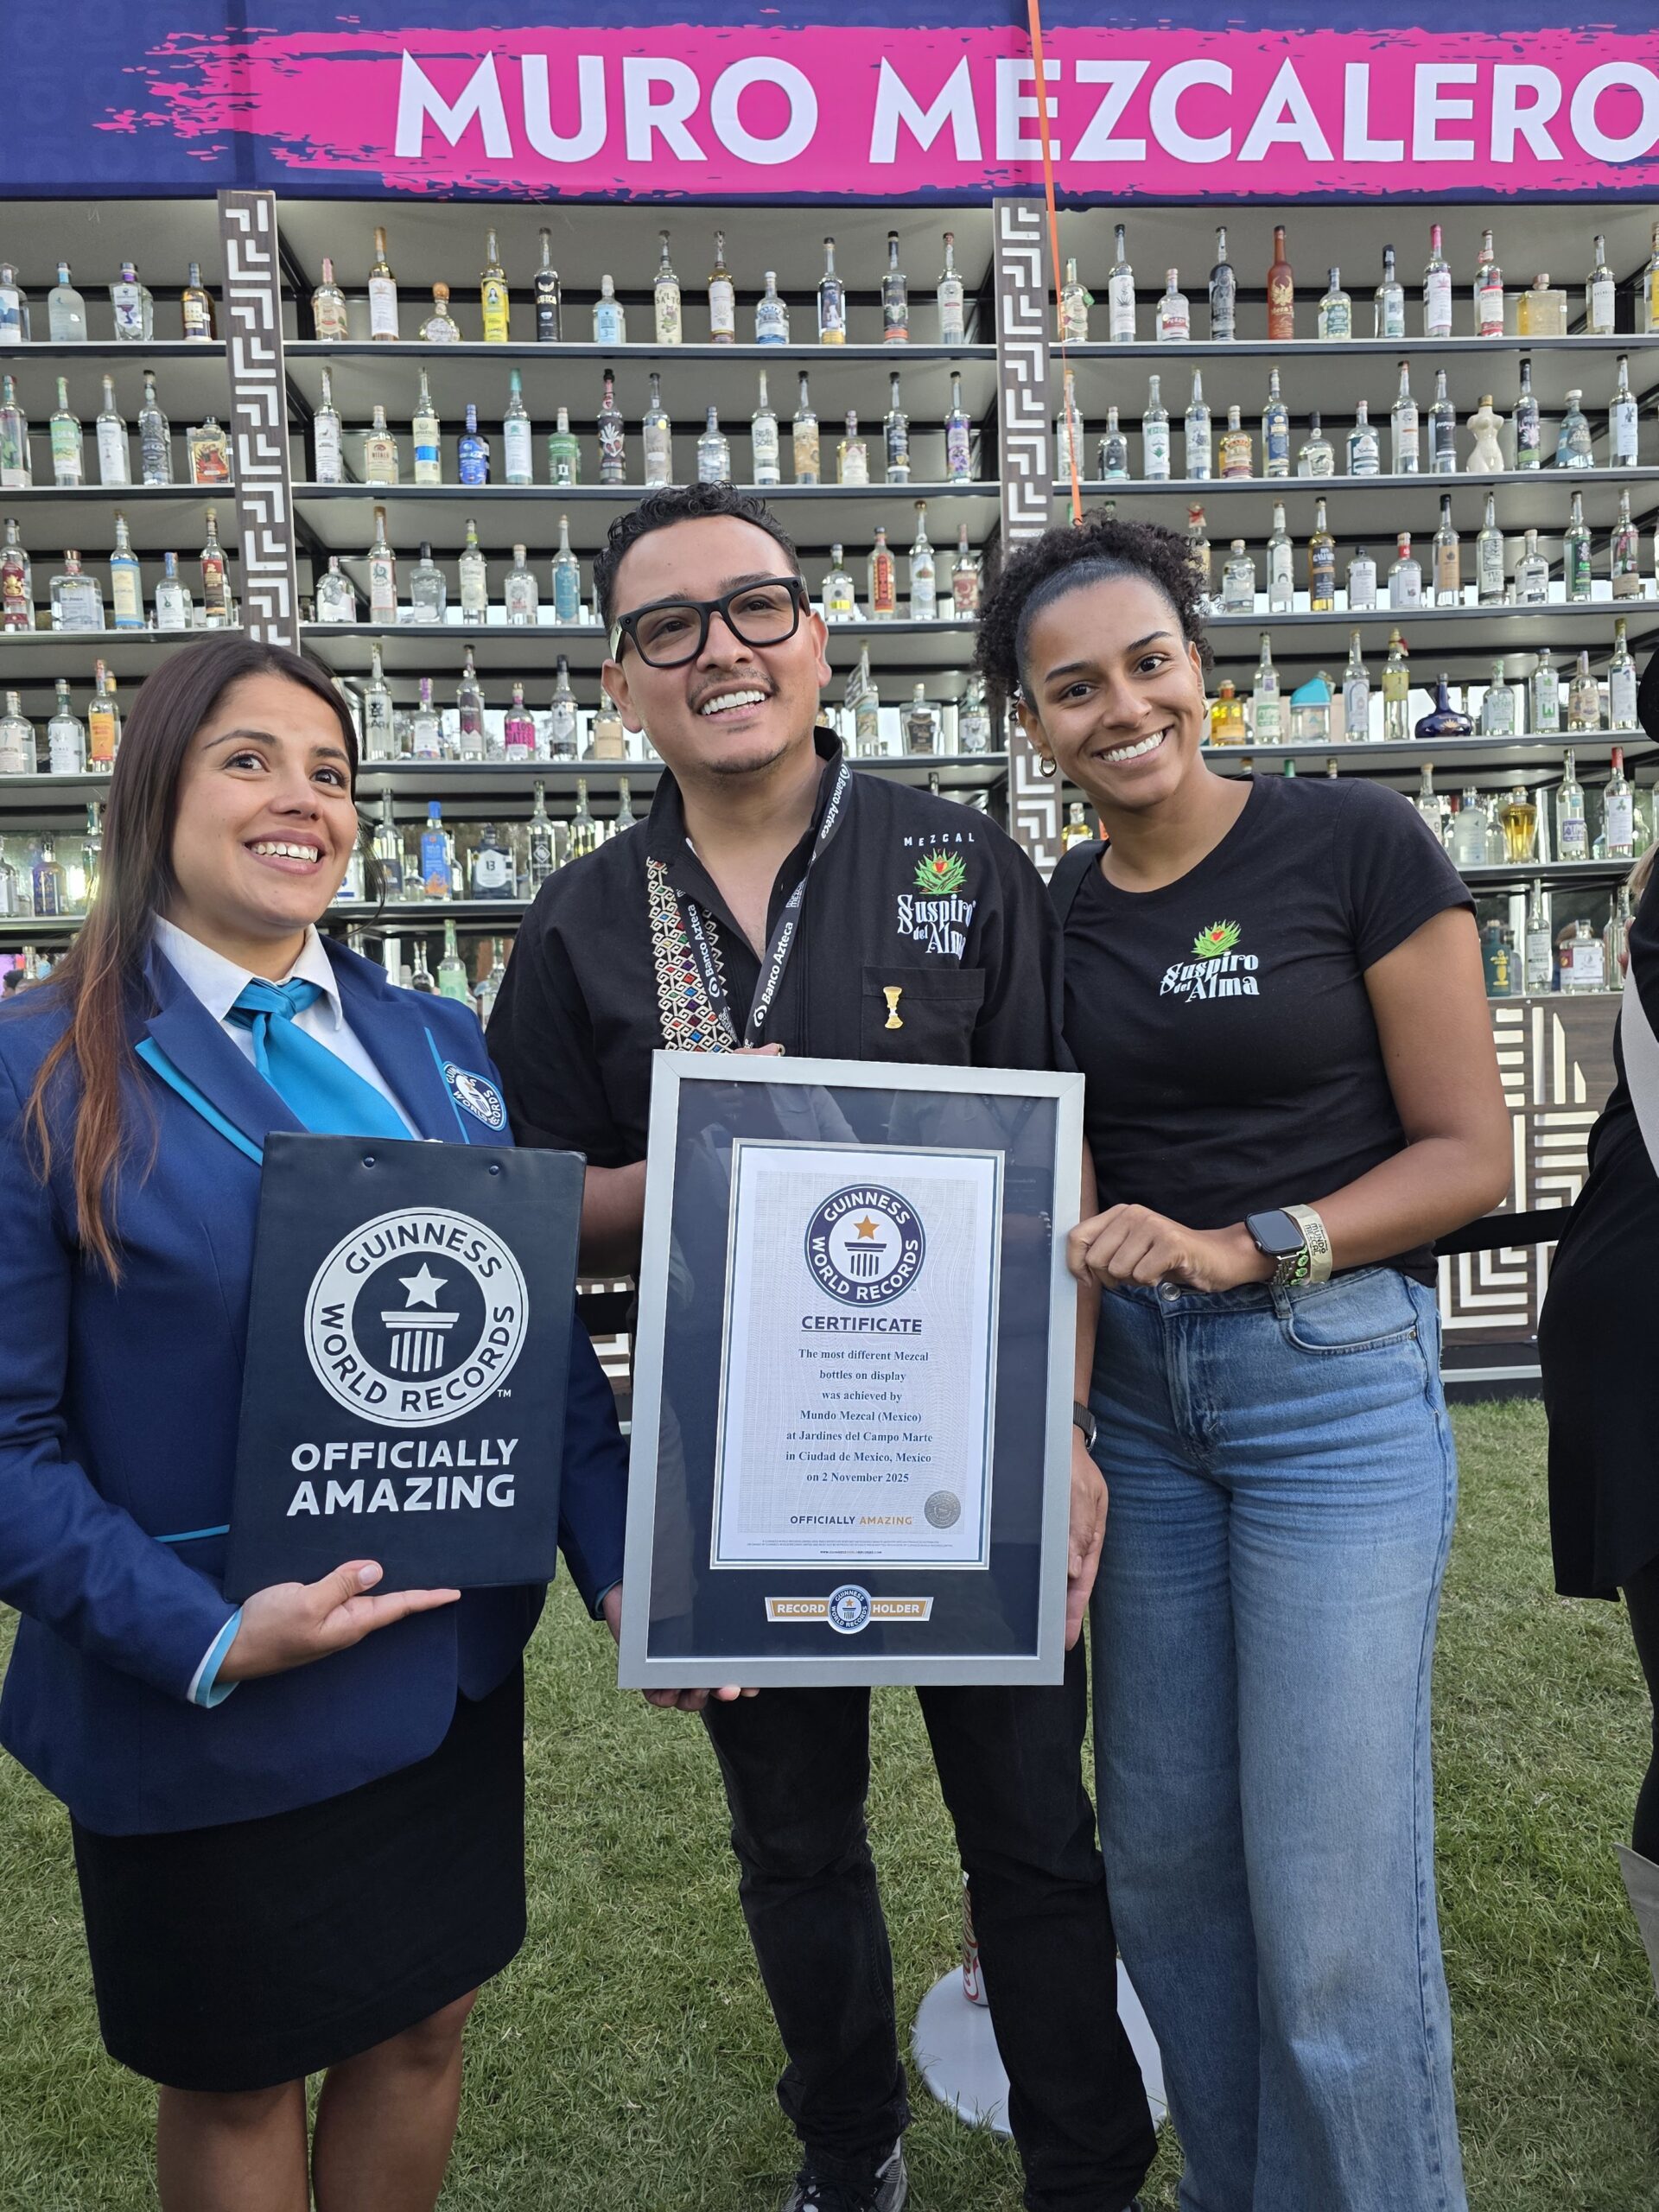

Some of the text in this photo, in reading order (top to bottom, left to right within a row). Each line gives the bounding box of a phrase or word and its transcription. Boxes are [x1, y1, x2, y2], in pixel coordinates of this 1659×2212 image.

[394, 48, 1659, 166] MURO MEZCALERO
[821, 778, 846, 839] Banco Azteca
[904, 832, 975, 847] MEZCAL
[897, 893, 974, 934] Suspiro
[688, 904, 715, 977] Banco Azteca
[913, 925, 928, 940] del
[763, 921, 795, 1005] Banco Azteca
[1160, 950, 1259, 996] Suspiro
[1173, 973, 1261, 1003] del Alma
[823, 1192, 911, 1224] GUINNESS
[345, 1222, 503, 1279] GUINNESS
[1305, 1224, 1319, 1255] MEZCAL
[1310, 1223, 1326, 1255] MUNDO
[812, 1236, 918, 1300] WORLD RECORDS
[802, 1315, 922, 1332] CERTIFICATE
[321, 1302, 515, 1413] WORLD RECORDS
[798, 1349, 929, 1362] The most different Mezcal
[819, 1370, 906, 1382] bottles on display
[497, 1389, 512, 1398] TM
[822, 1390, 903, 1403] was achieved by
[800, 1410, 922, 1424] Mundo Mezcal (Mexico)
[786, 1431, 933, 1444] at Jardines del Campo Marte
[291, 1438, 518, 1471] OFFICIALLY
[785, 1452, 931, 1464] in Ciudad de Mexico, Mexico
[806, 1471, 910, 1483] on 2 November 2025
[286, 1474, 516, 1516] AMAZING
[790, 1516, 912, 1526] OFFICIALLY AMAZING
[835, 1590, 865, 1602] GUINNESS
[777, 1604, 826, 1613] RECORD
[831, 1605, 868, 1628] WORLD RECORDS
[873, 1604, 919, 1613] HOLDER
